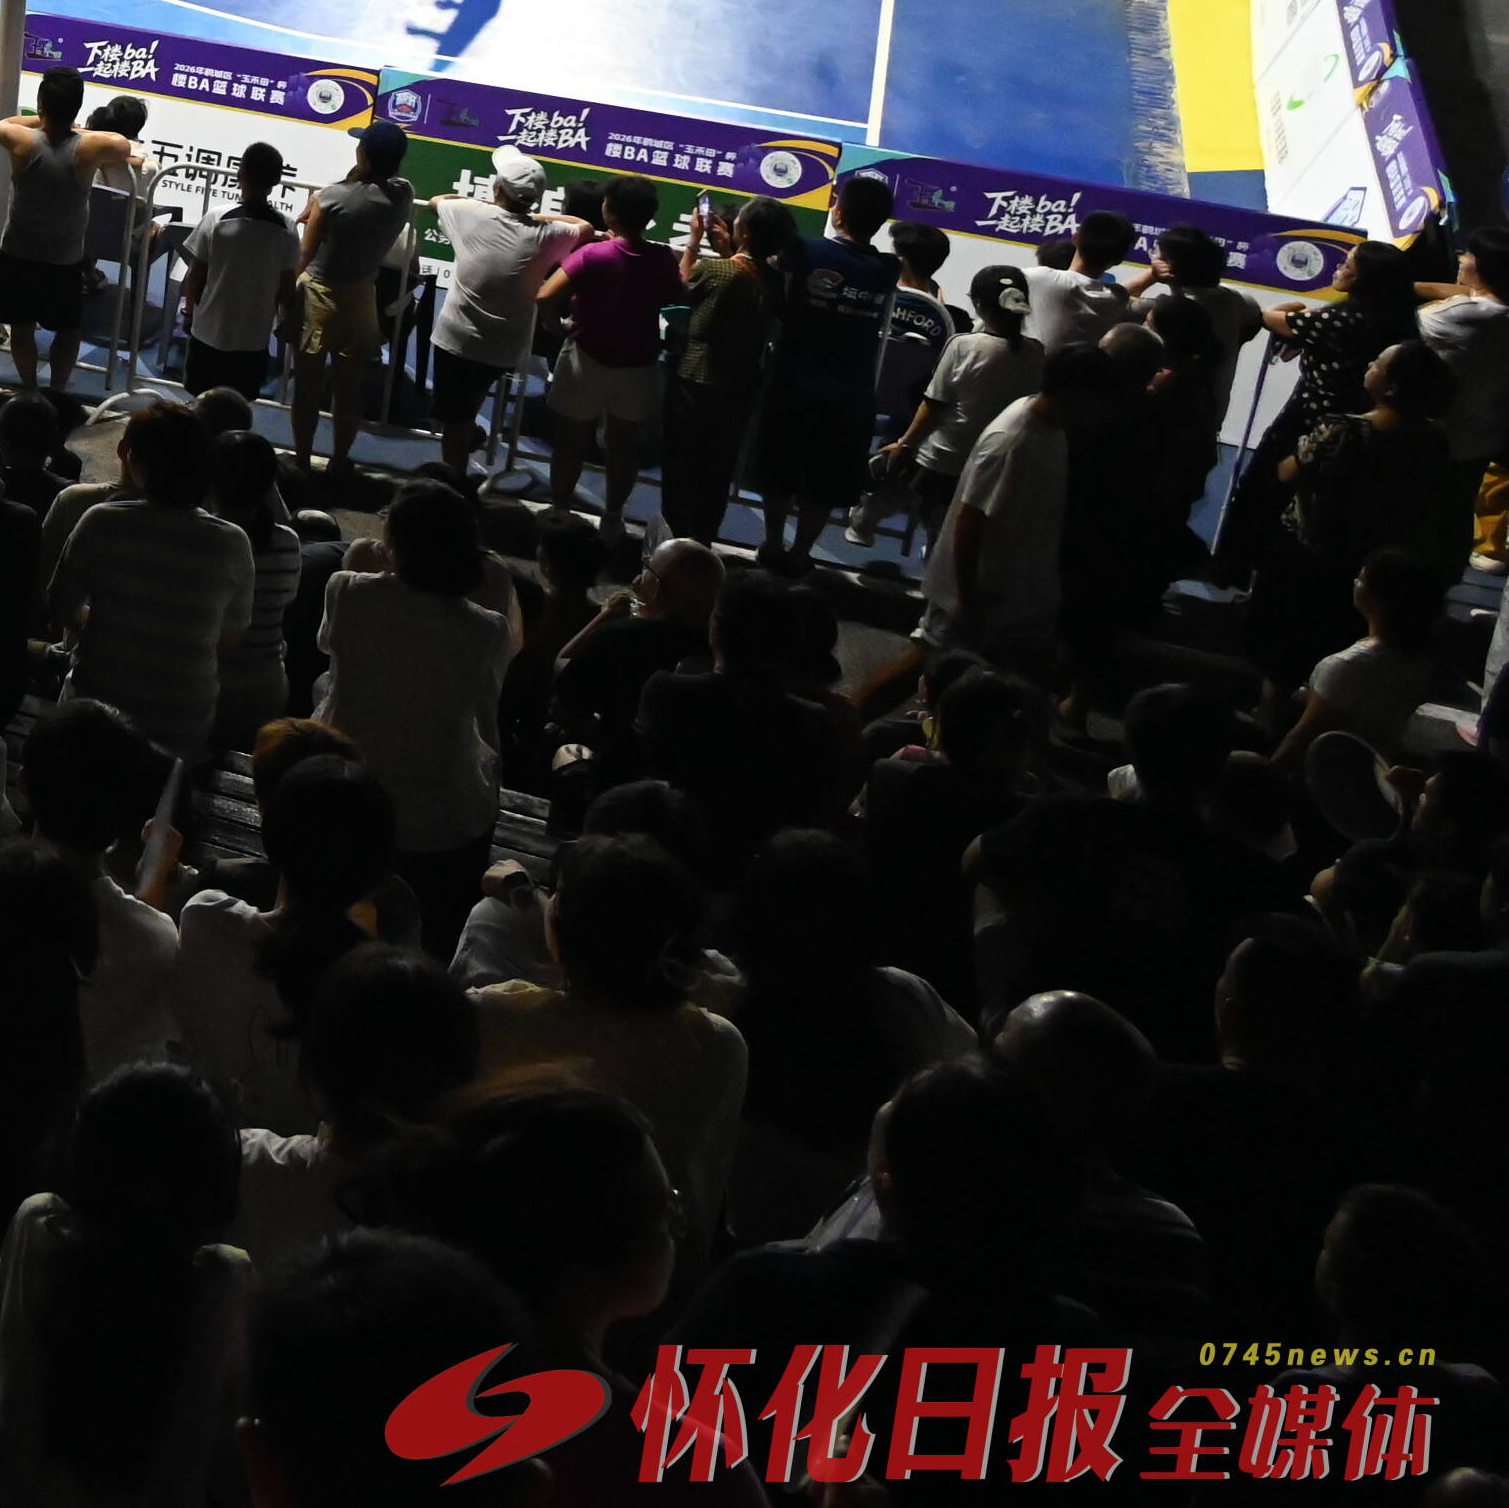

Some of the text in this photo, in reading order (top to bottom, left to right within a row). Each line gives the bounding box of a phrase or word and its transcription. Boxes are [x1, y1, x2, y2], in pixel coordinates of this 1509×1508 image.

[83, 39, 160, 65] 下楼ba!
[77, 59, 160, 82] 一起楼BA
[171, 73, 286, 105] 楼BA篮球联赛
[505, 107, 591, 133] 下楼ba!
[496, 128, 591, 152] 一起楼BA
[605, 143, 735, 179] 楼BA篮球联赛
[161, 179, 193, 192] STYLE
[983, 191, 1081, 218] 下楼ba!
[975, 213, 1081, 236] 一起楼BA
